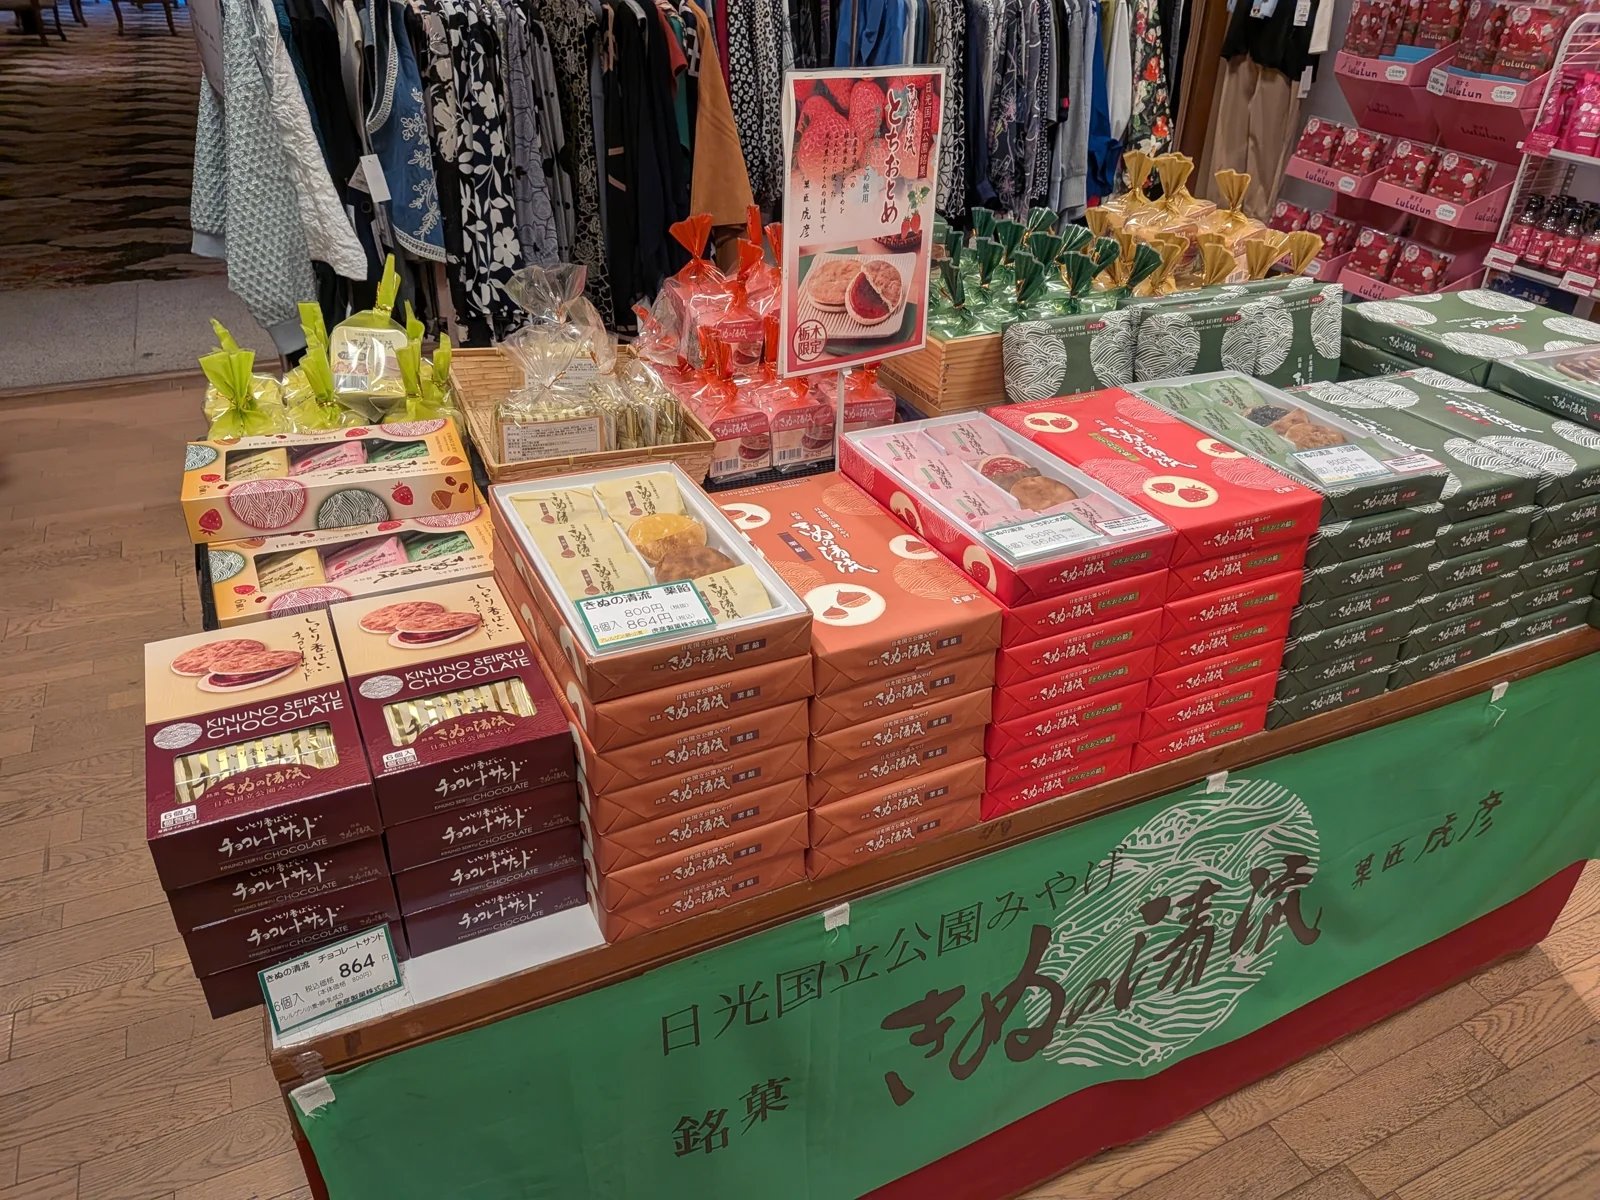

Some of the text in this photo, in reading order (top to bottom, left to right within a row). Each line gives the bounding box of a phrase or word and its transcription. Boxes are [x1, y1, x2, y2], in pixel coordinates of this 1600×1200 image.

[881, 88, 902, 224] とちおとめ
[1395, 197, 1431, 216] LuLuLun
[798, 324, 822, 341] 栃木
[797, 340, 822, 356] 限定
[791, 521, 879, 574] きぬの清流
[1032, 534, 1067, 547] 864円
[583, 591, 652, 610] きぬの清流
[624, 603, 665, 618] 800円
[951, 593, 981, 605] 8個入
[593, 620, 622, 633] 8個入
[626, 612, 674, 630] 864円
[651, 618, 711, 634] 虎彦製菓株式会社
[405, 649, 526, 681] KINUNO SEIRYU
[668, 645, 734, 671] きぬの清流
[881, 641, 934, 666] きぬの清流
[408, 657, 532, 690] CHOCOLATE
[875, 681, 928, 707] きぬの清流
[206, 690, 340, 729] KINUNO SEIRYU
[207, 699, 345, 739] CHOCOLATE
[664, 694, 729, 721] きぬの清流
[434, 716, 516, 741] きぬの清流
[873, 722, 925, 747] きぬの清流
[664, 737, 728, 765] きぬの清流
[434, 759, 528, 797] チョコレートサンド
[870, 753, 920, 778] きぬの清流
[221, 766, 312, 796] きぬの清流
[473, 781, 529, 801] CHOCOLATE
[669, 776, 731, 804] きぬの清流
[164, 808, 193, 820] 6個入
[872, 794, 922, 819] きぬの清流
[218, 815, 323, 857] チョコレートサンド
[442, 806, 532, 844] チョコレートサンド
[478, 827, 533, 847] CHOCOLATE
[669, 815, 730, 843] きぬの清流
[264, 837, 328, 860] CHOCOLATE
[866, 827, 915, 852] きぬの清流
[450, 848, 538, 886] チョコレートサンド
[486, 867, 539, 889] CHOCOLATE
[673, 853, 732, 880] きぬの清流
[232, 859, 333, 901] チョコレートサンド
[275, 880, 338, 903] CHOCOLATE
[458, 891, 544, 929] チョコレートサンド
[672, 886, 731, 913] きぬの清流
[247, 905, 344, 946] チョコレートサンド
[493, 910, 544, 932] CHOCOLATE
[289, 925, 349, 948] CHOCOLATE
[266, 932, 385, 983] きぬの清流 チョコレートサンド
[660, 846, 1128, 1056] 日光国立公園みやげ
[304, 953, 390, 993] 税込価格 864 円
[880, 855, 1322, 1106] きぬの清流
[274, 992, 305, 1012] 6個入
[335, 978, 397, 1008] 虎彦製菓株式会社
[671, 1076, 792, 1159] 銘菓
